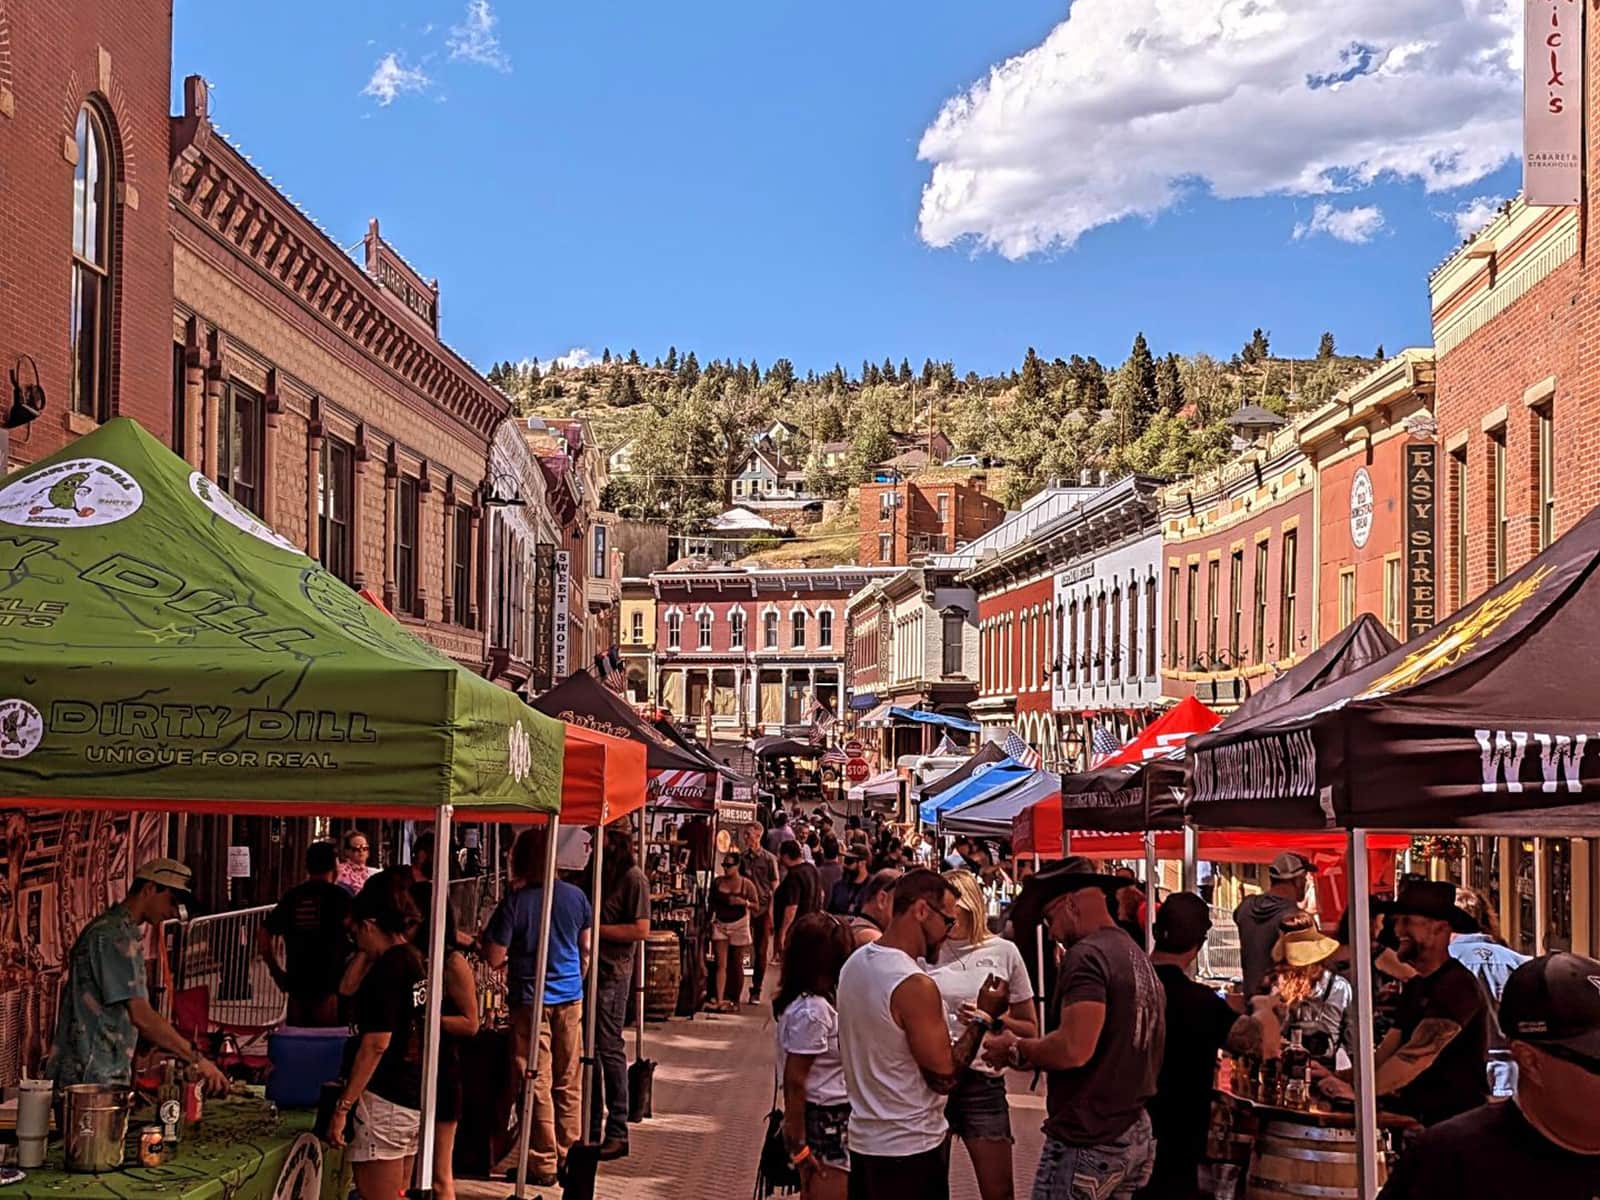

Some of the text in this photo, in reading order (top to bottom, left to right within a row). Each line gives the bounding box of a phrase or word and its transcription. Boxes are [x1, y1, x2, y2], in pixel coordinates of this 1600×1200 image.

[1546, 0, 1565, 114] ick's
[1411, 451, 1434, 519] EASY
[78, 551, 314, 653] DILL
[557, 552, 568, 603] SWEET
[556, 613, 566, 675] SHOPPE
[49, 700, 377, 743] DIRTY DILL
[85, 743, 339, 770] UNIQUE FOR REAL
[847, 765, 868, 776] STOP
[1474, 729, 1600, 793] WW
[719, 808, 753, 821] FIRESIDE
